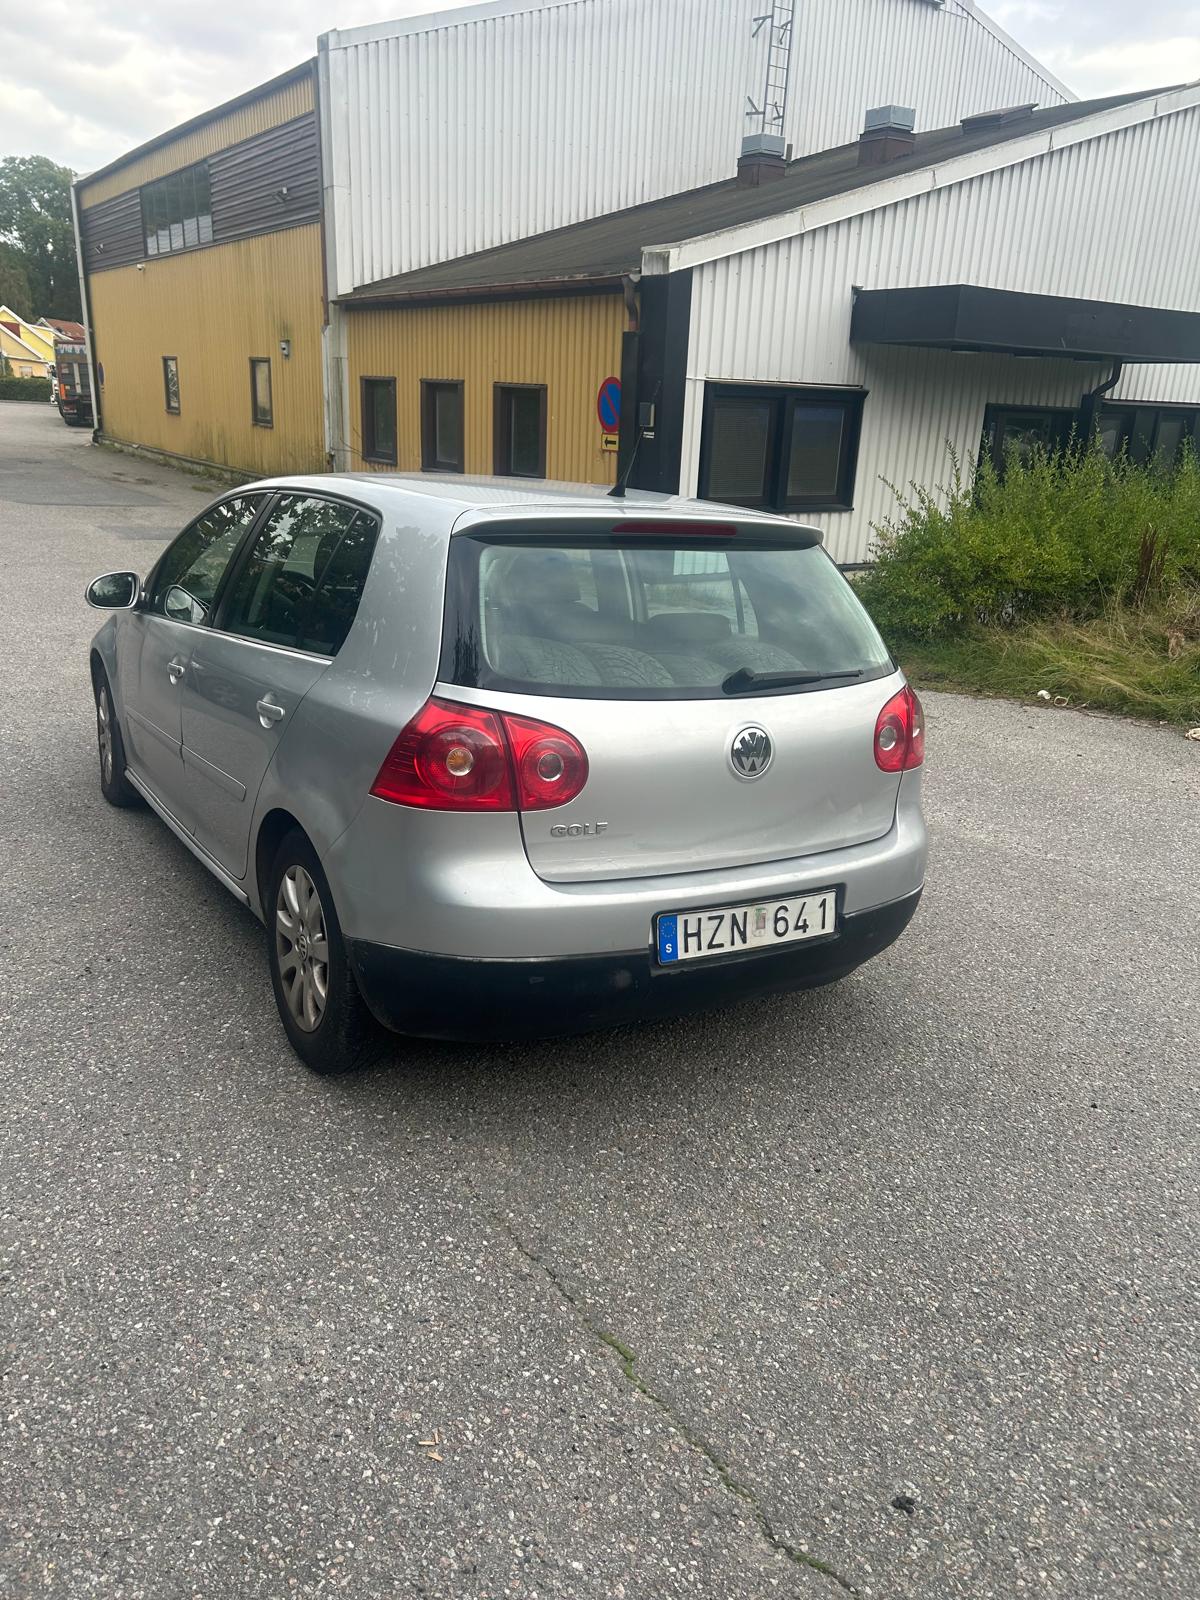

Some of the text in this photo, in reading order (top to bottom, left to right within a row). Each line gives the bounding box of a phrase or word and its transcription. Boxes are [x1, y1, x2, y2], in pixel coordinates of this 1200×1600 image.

[550, 822, 608, 838] GOLF
[683, 911, 748, 953] HZN
[773, 897, 827, 938] 641
[665, 943, 673, 954] S
